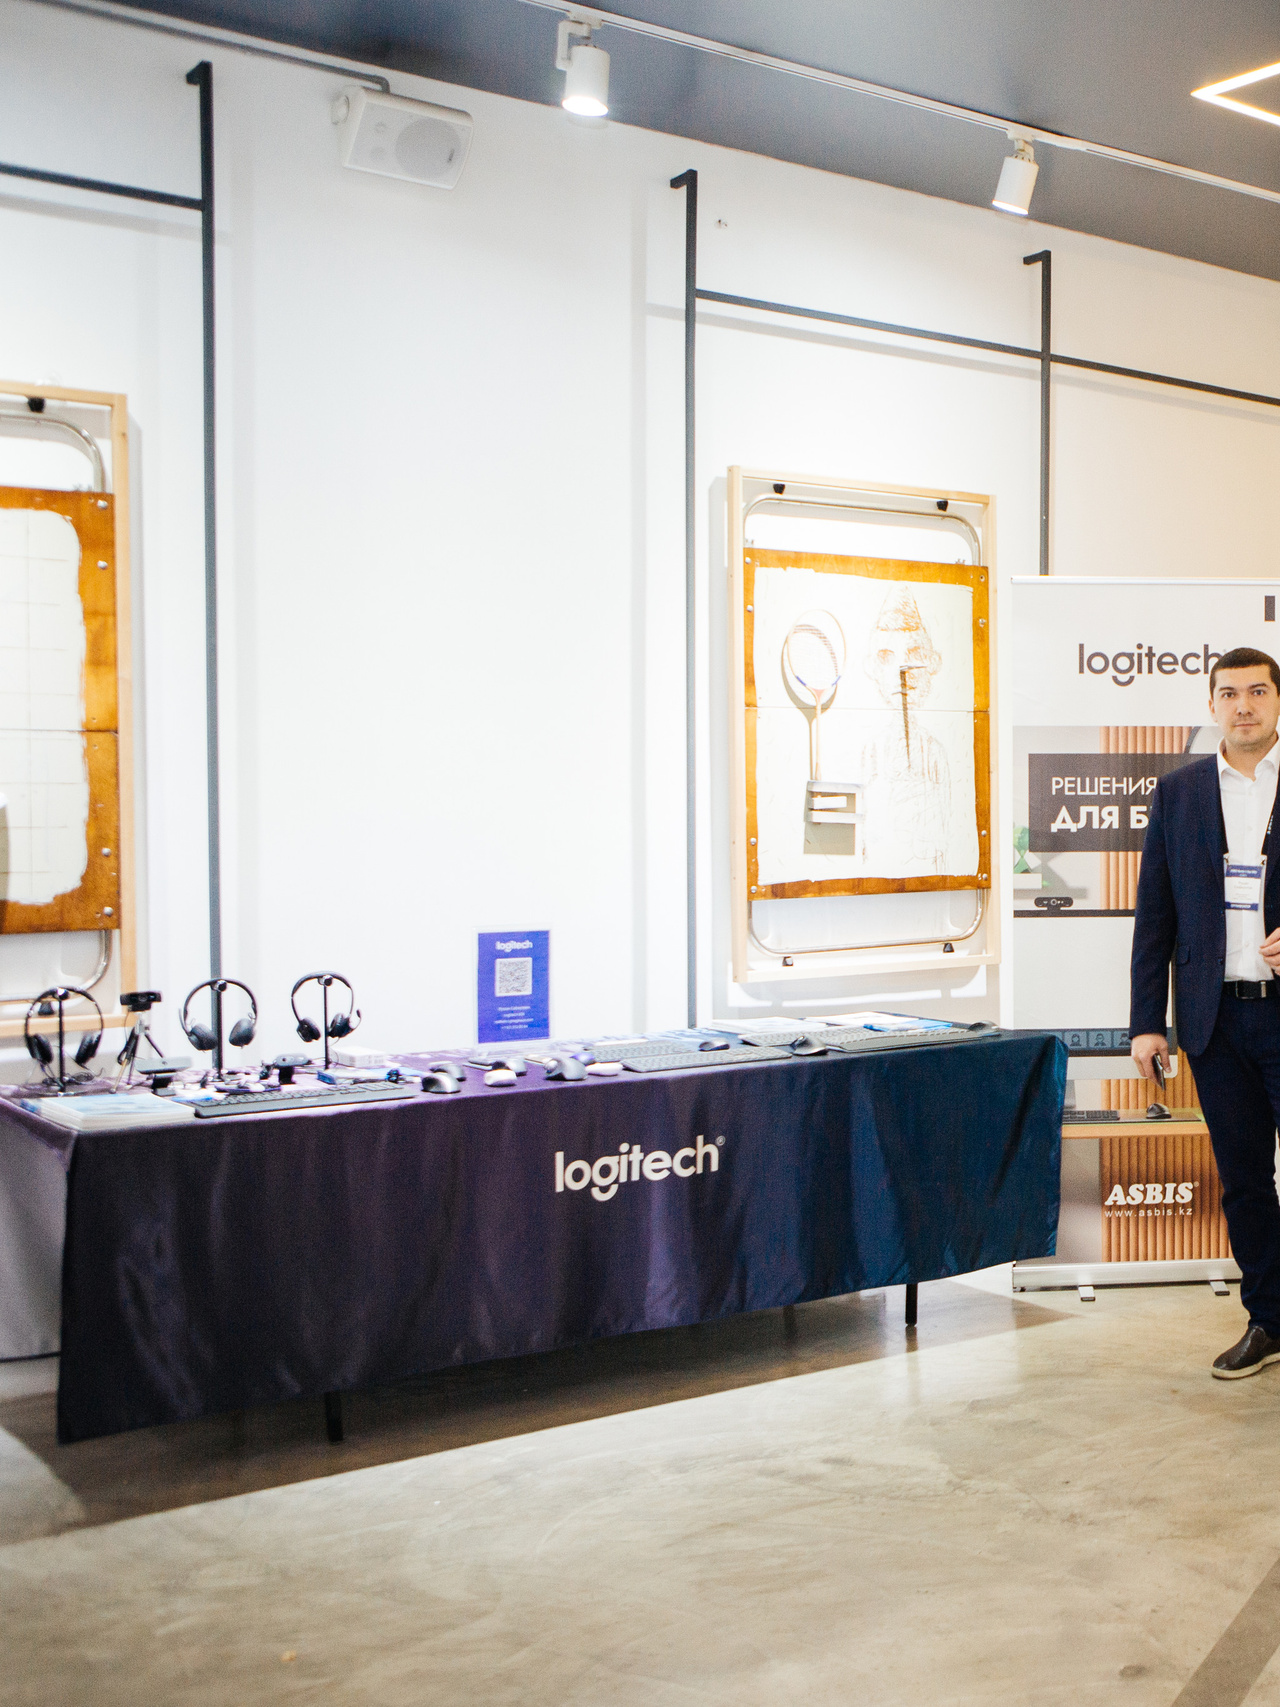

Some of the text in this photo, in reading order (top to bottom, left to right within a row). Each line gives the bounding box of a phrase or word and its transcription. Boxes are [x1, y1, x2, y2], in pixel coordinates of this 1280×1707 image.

[1052, 777, 1157, 795] РЕШЕНИЯ
[1051, 806, 1119, 832] ДЛЯ
[555, 1135, 718, 1201] logitech
[1105, 1183, 1193, 1205] ASBIS
[1105, 1207, 1192, 1218] www.asbis.kz
